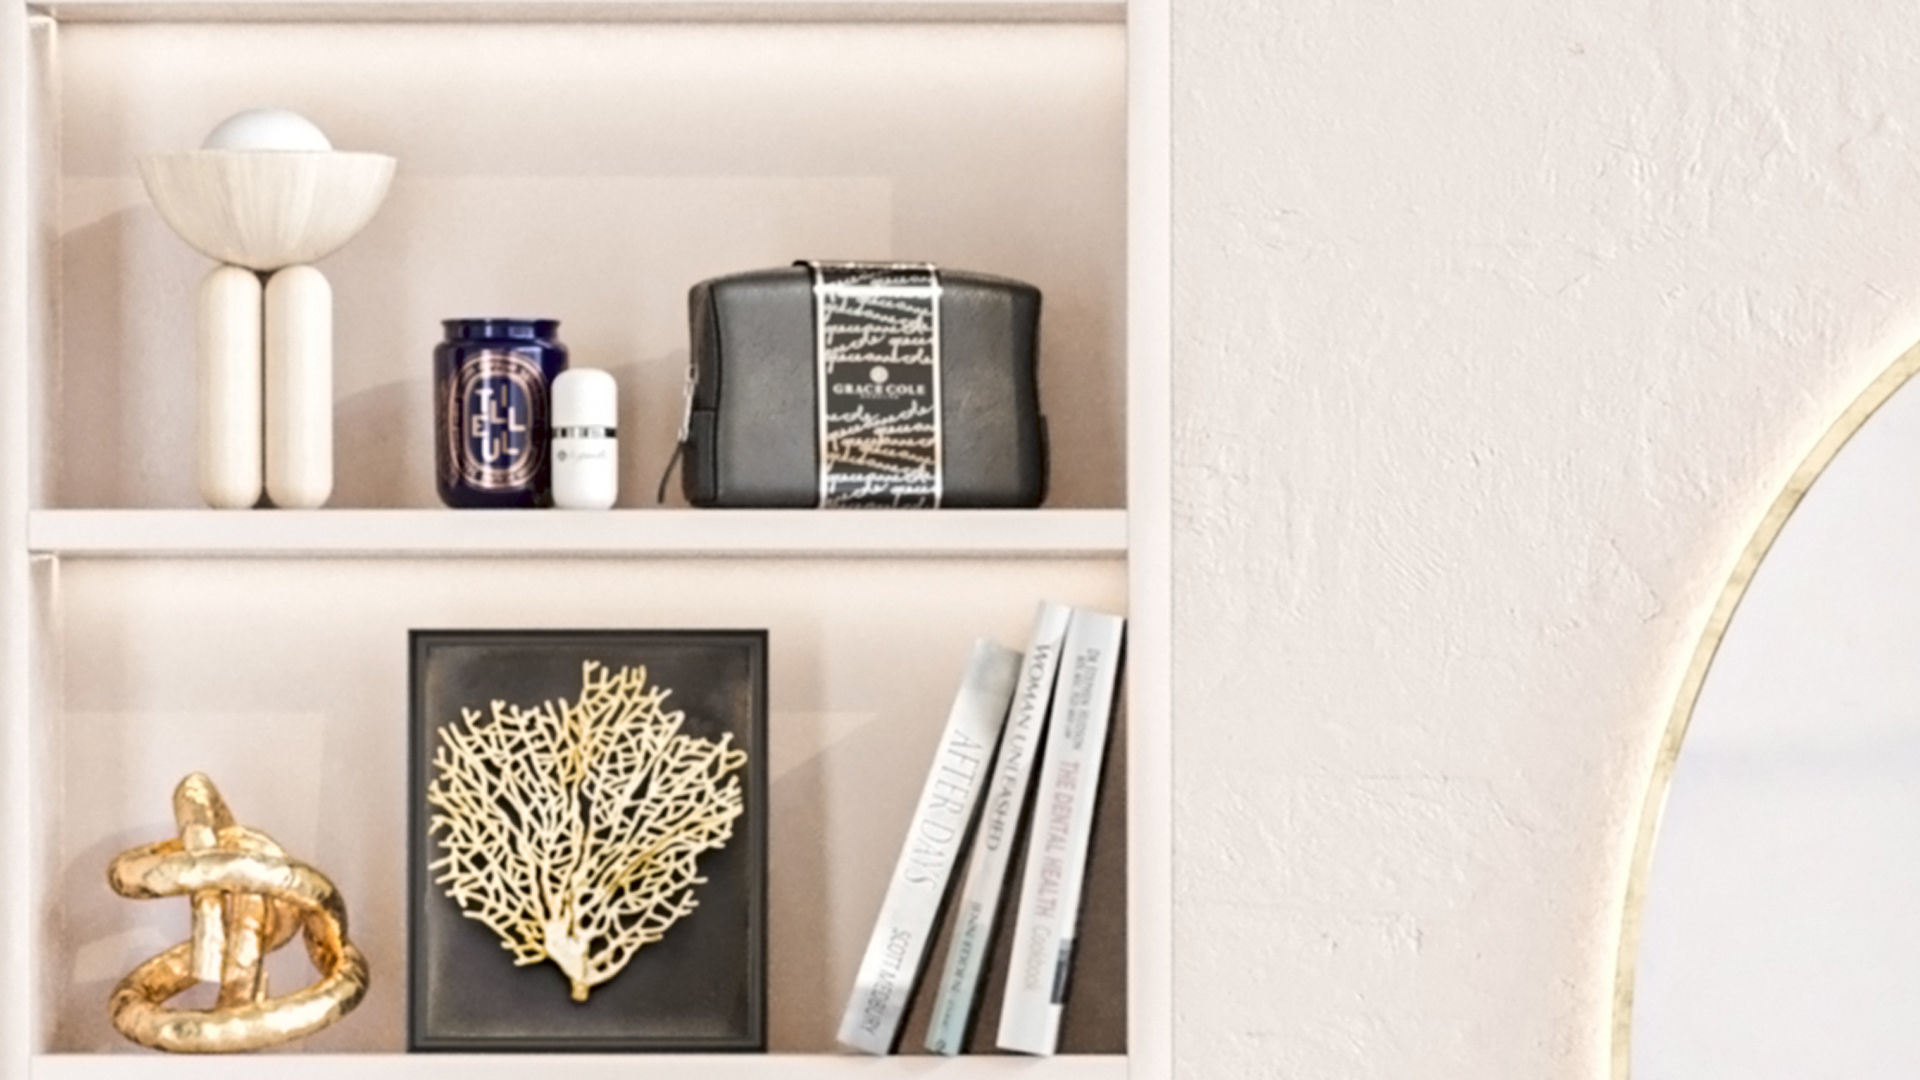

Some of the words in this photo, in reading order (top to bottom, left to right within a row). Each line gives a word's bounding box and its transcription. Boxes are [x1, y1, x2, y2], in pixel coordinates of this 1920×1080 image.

[832, 383, 883, 395] GRACE
[885, 383, 926, 396] COLE
[1016, 644, 1051, 730] WOMAN
[928, 728, 983, 816] AFTER
[986, 733, 1027, 852] UNLEASHED
[1055, 760, 1080, 790] THE
[903, 818, 955, 891] DAYS
[1044, 791, 1074, 853] DENTAL
[1033, 855, 1063, 920] HEALTH
[883, 926, 912, 972] SCOTT
[1023, 924, 1052, 992] Cookbook
